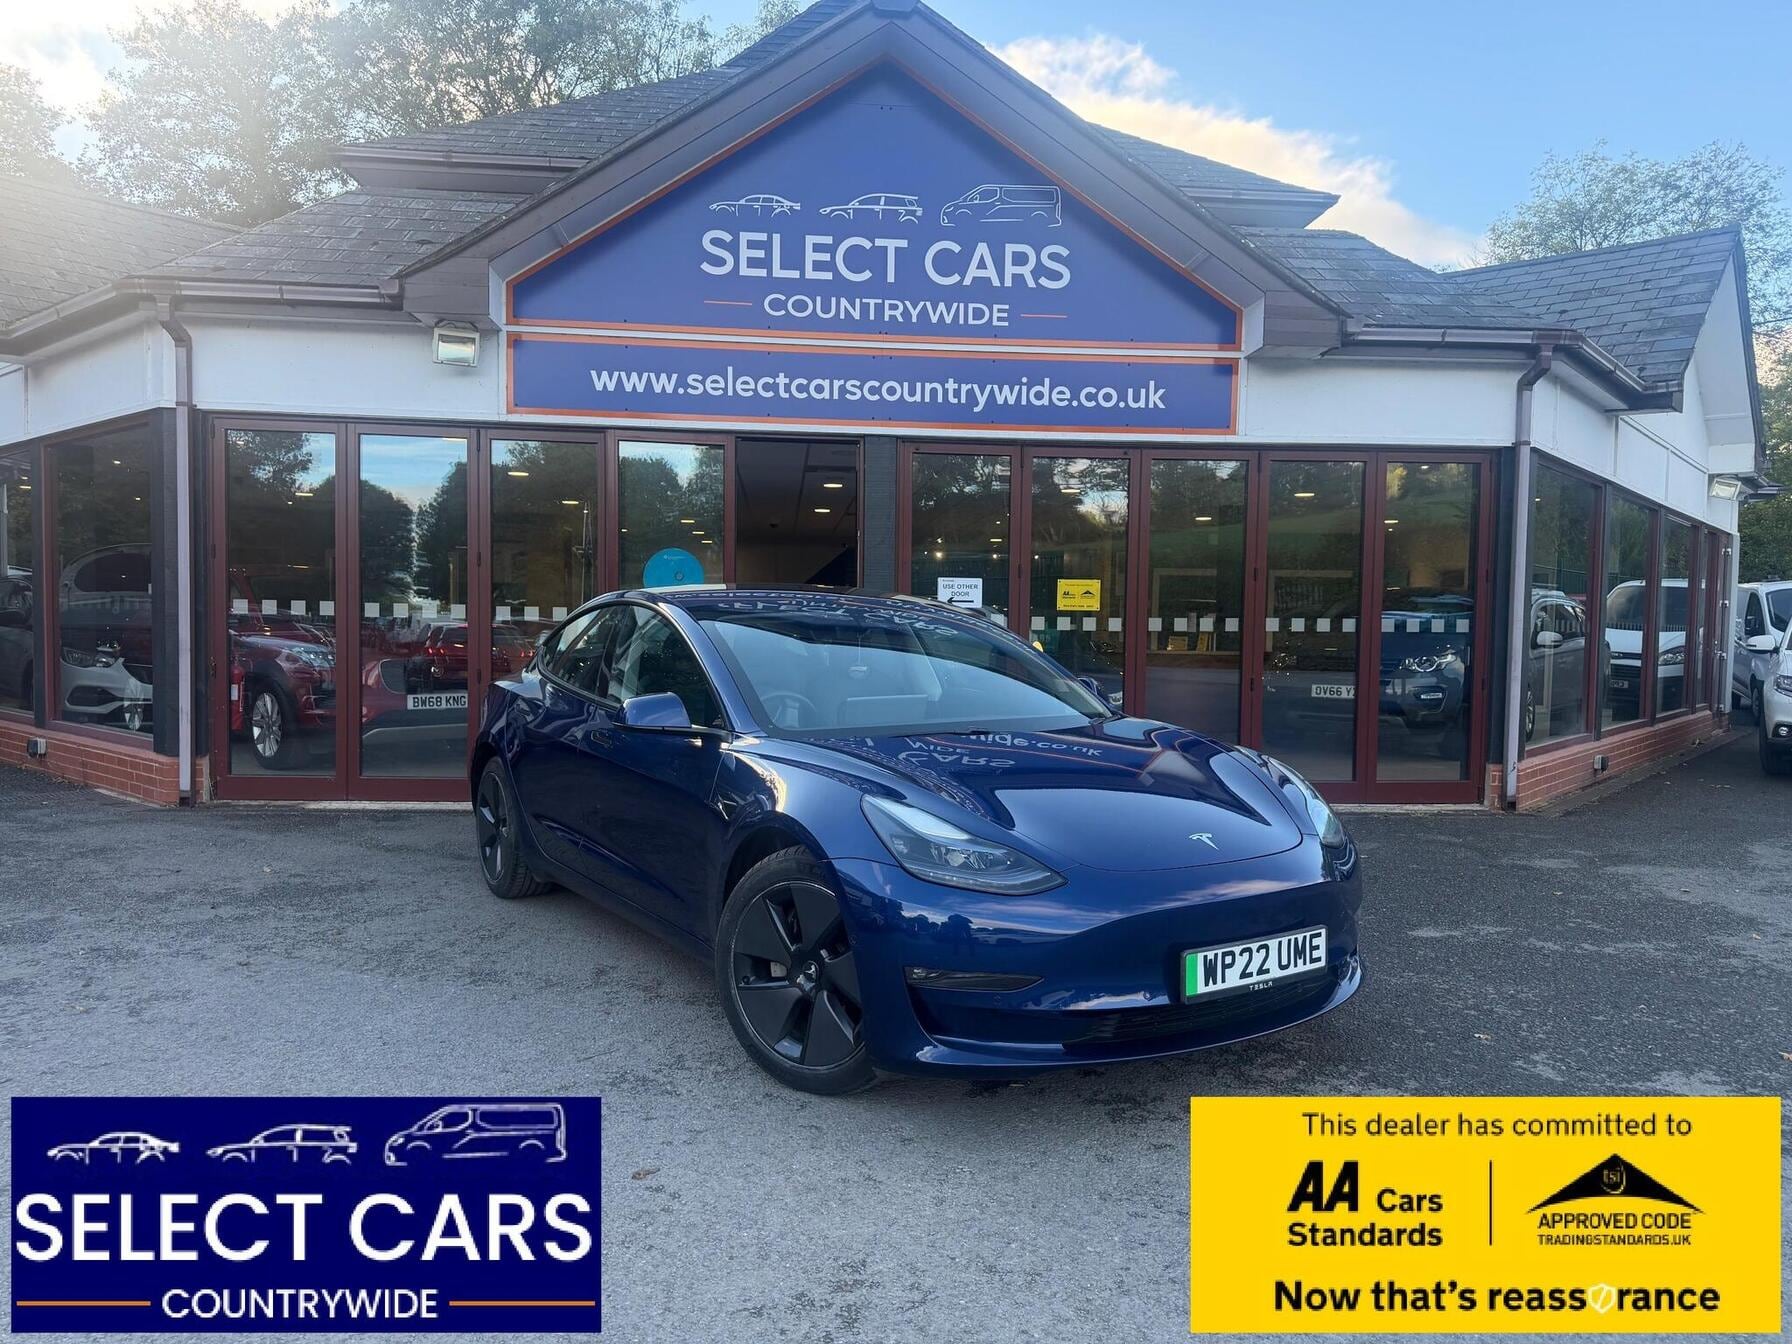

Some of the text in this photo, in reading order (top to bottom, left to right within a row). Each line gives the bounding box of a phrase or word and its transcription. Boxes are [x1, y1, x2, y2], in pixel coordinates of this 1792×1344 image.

[701, 229, 1071, 289] SELECT CARS
[763, 293, 1010, 327] COUNTRYWIDE
[590, 365, 1167, 412] www.selectcarscountrywide.co.uk
[412, 695, 467, 708] BW68 KNG
[1314, 686, 1343, 696] OV66
[1202, 931, 1323, 987] WP22 UME
[1249, 980, 1274, 991] TESLA
